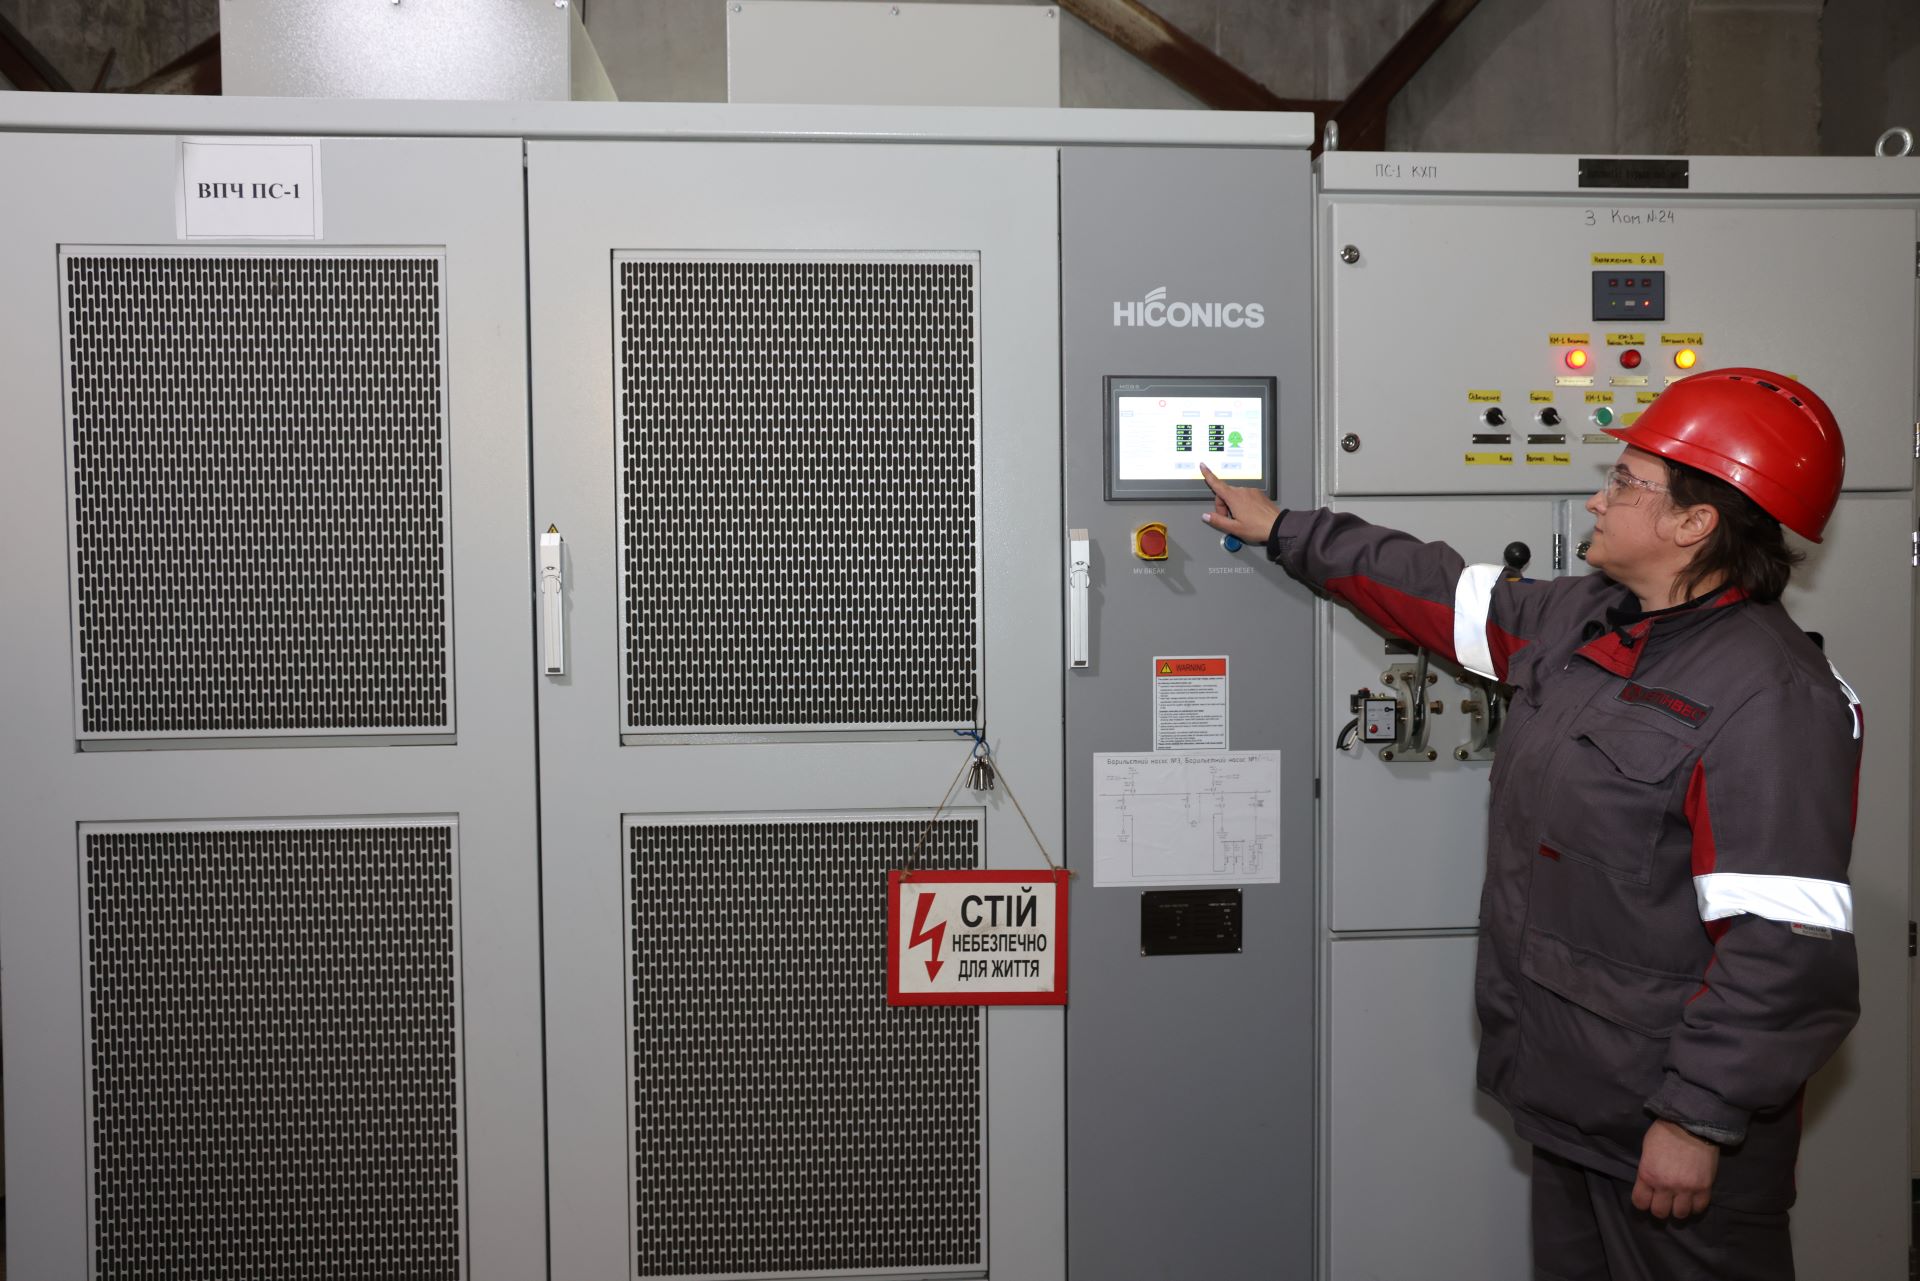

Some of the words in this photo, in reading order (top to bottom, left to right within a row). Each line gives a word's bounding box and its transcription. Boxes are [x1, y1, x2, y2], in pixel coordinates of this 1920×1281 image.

[1411, 165, 1438, 179] КХП
[197, 182, 244, 199] ВПЧ
[251, 182, 301, 199] ПС-1
[1113, 286, 1265, 329] HICONICS
[1208, 567, 1232, 575] SYSTEM
[1175, 663, 1206, 672] WARNING
[960, 886, 1038, 928] СТІЙ
[952, 934, 1047, 952] НЕБЕЗПЕЧНО
[958, 959, 988, 981] ДЛЯ
[991, 959, 1040, 978] ЖИТТЯ
